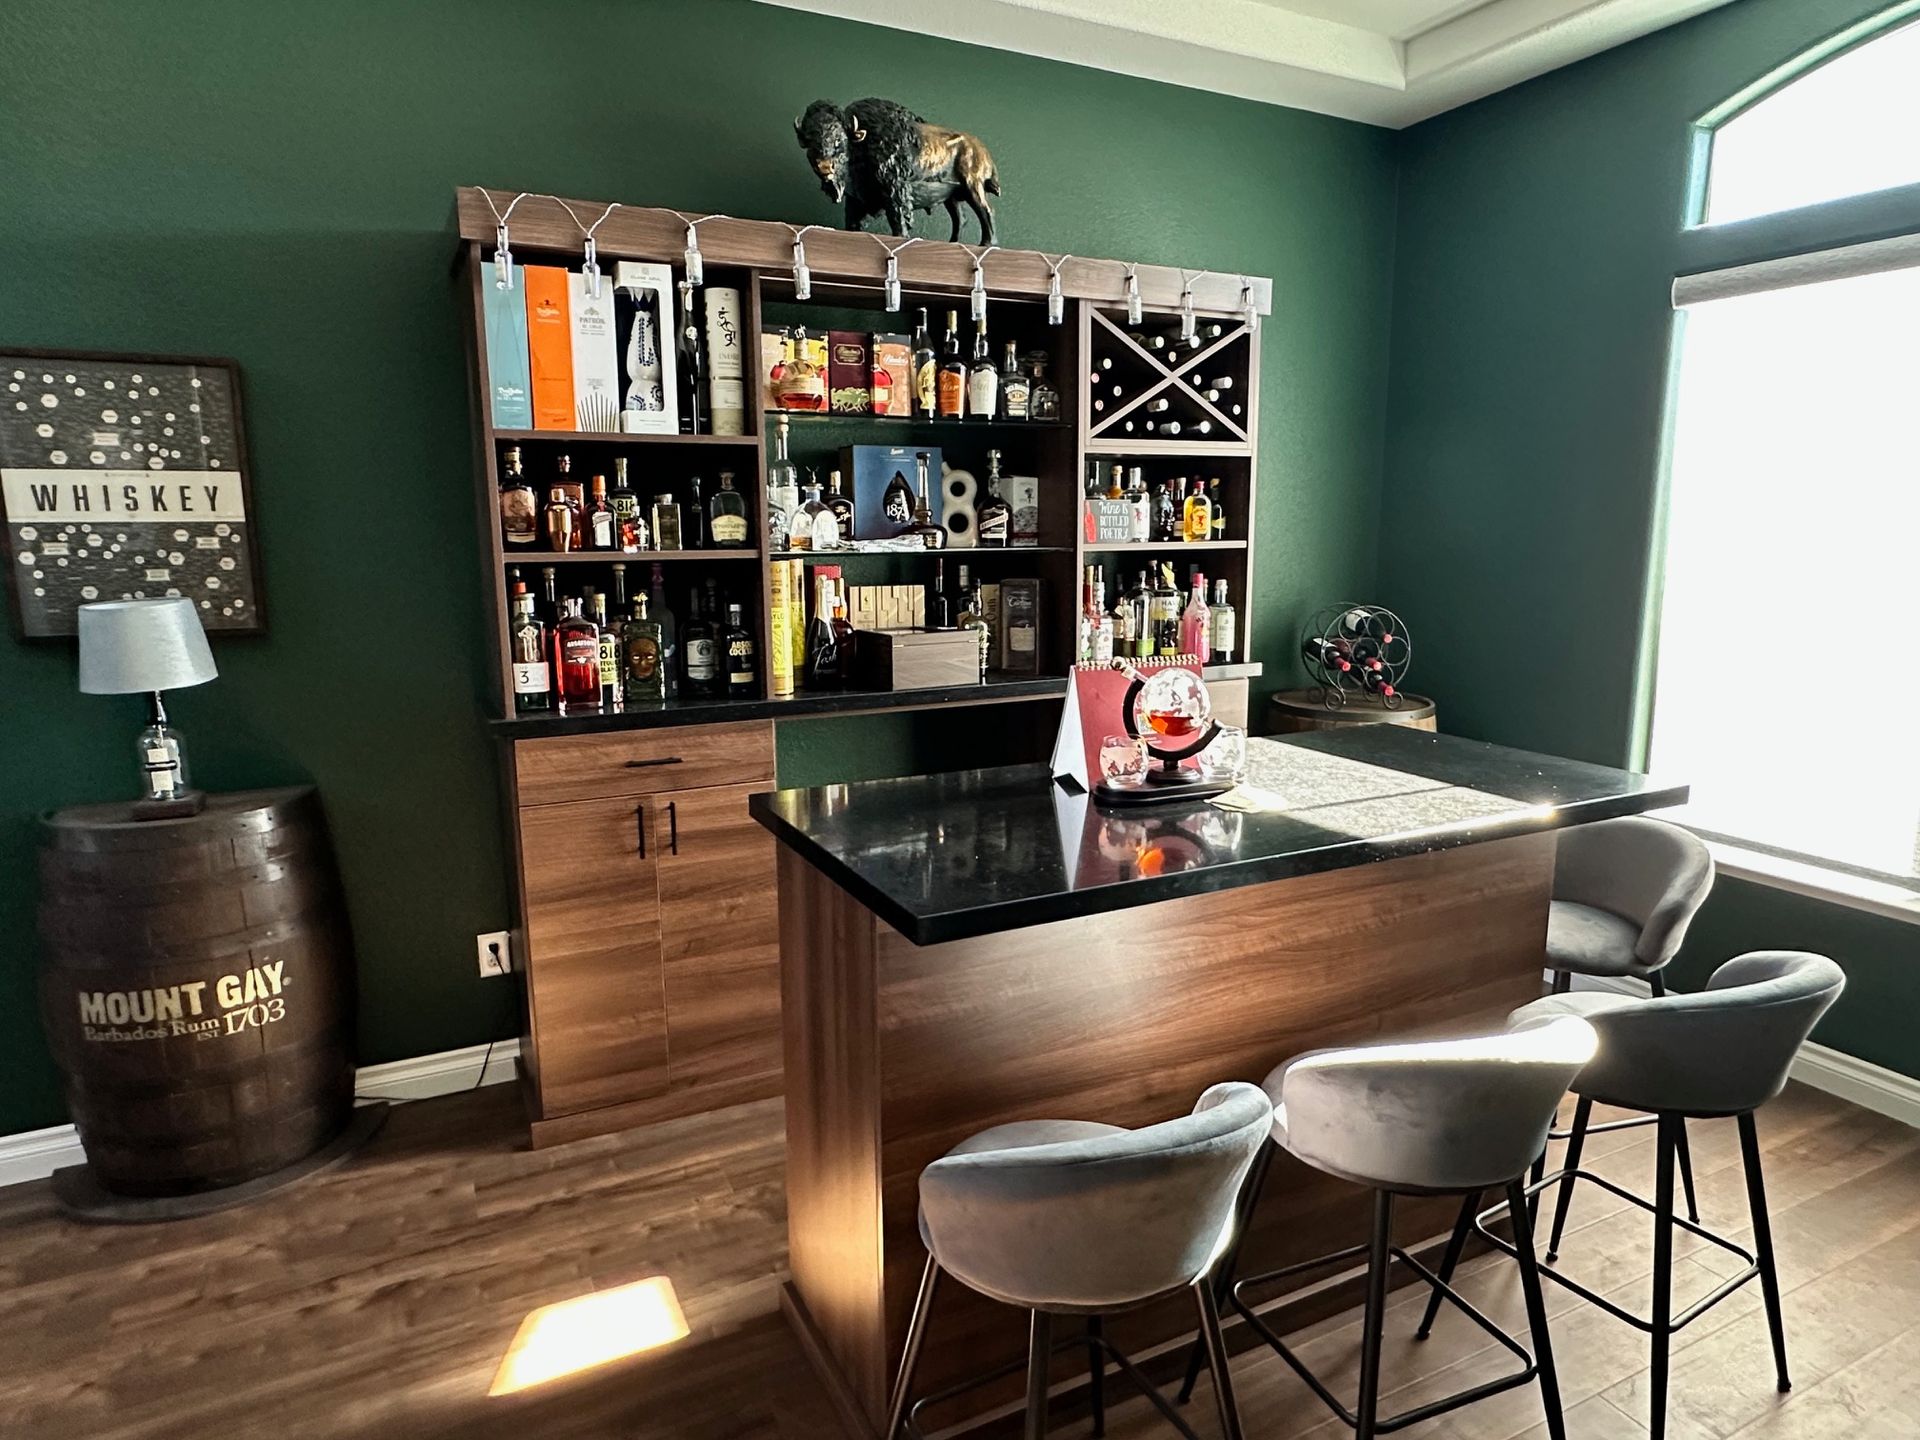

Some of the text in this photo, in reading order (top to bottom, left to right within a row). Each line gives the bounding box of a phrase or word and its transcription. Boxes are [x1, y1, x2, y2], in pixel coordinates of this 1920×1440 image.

[30, 484, 220, 512] WHISKEY
[1098, 502, 1121, 514] Wine
[1099, 515, 1129, 527] BOTTLED
[1099, 528, 1129, 541] POETRY
[599, 644, 621, 660] 818
[519, 670, 530, 685] 3
[79, 960, 285, 1025] MOUNT GAY
[196, 997, 286, 1041] EST 1703
[83, 1017, 220, 1042] Barbados Rum
